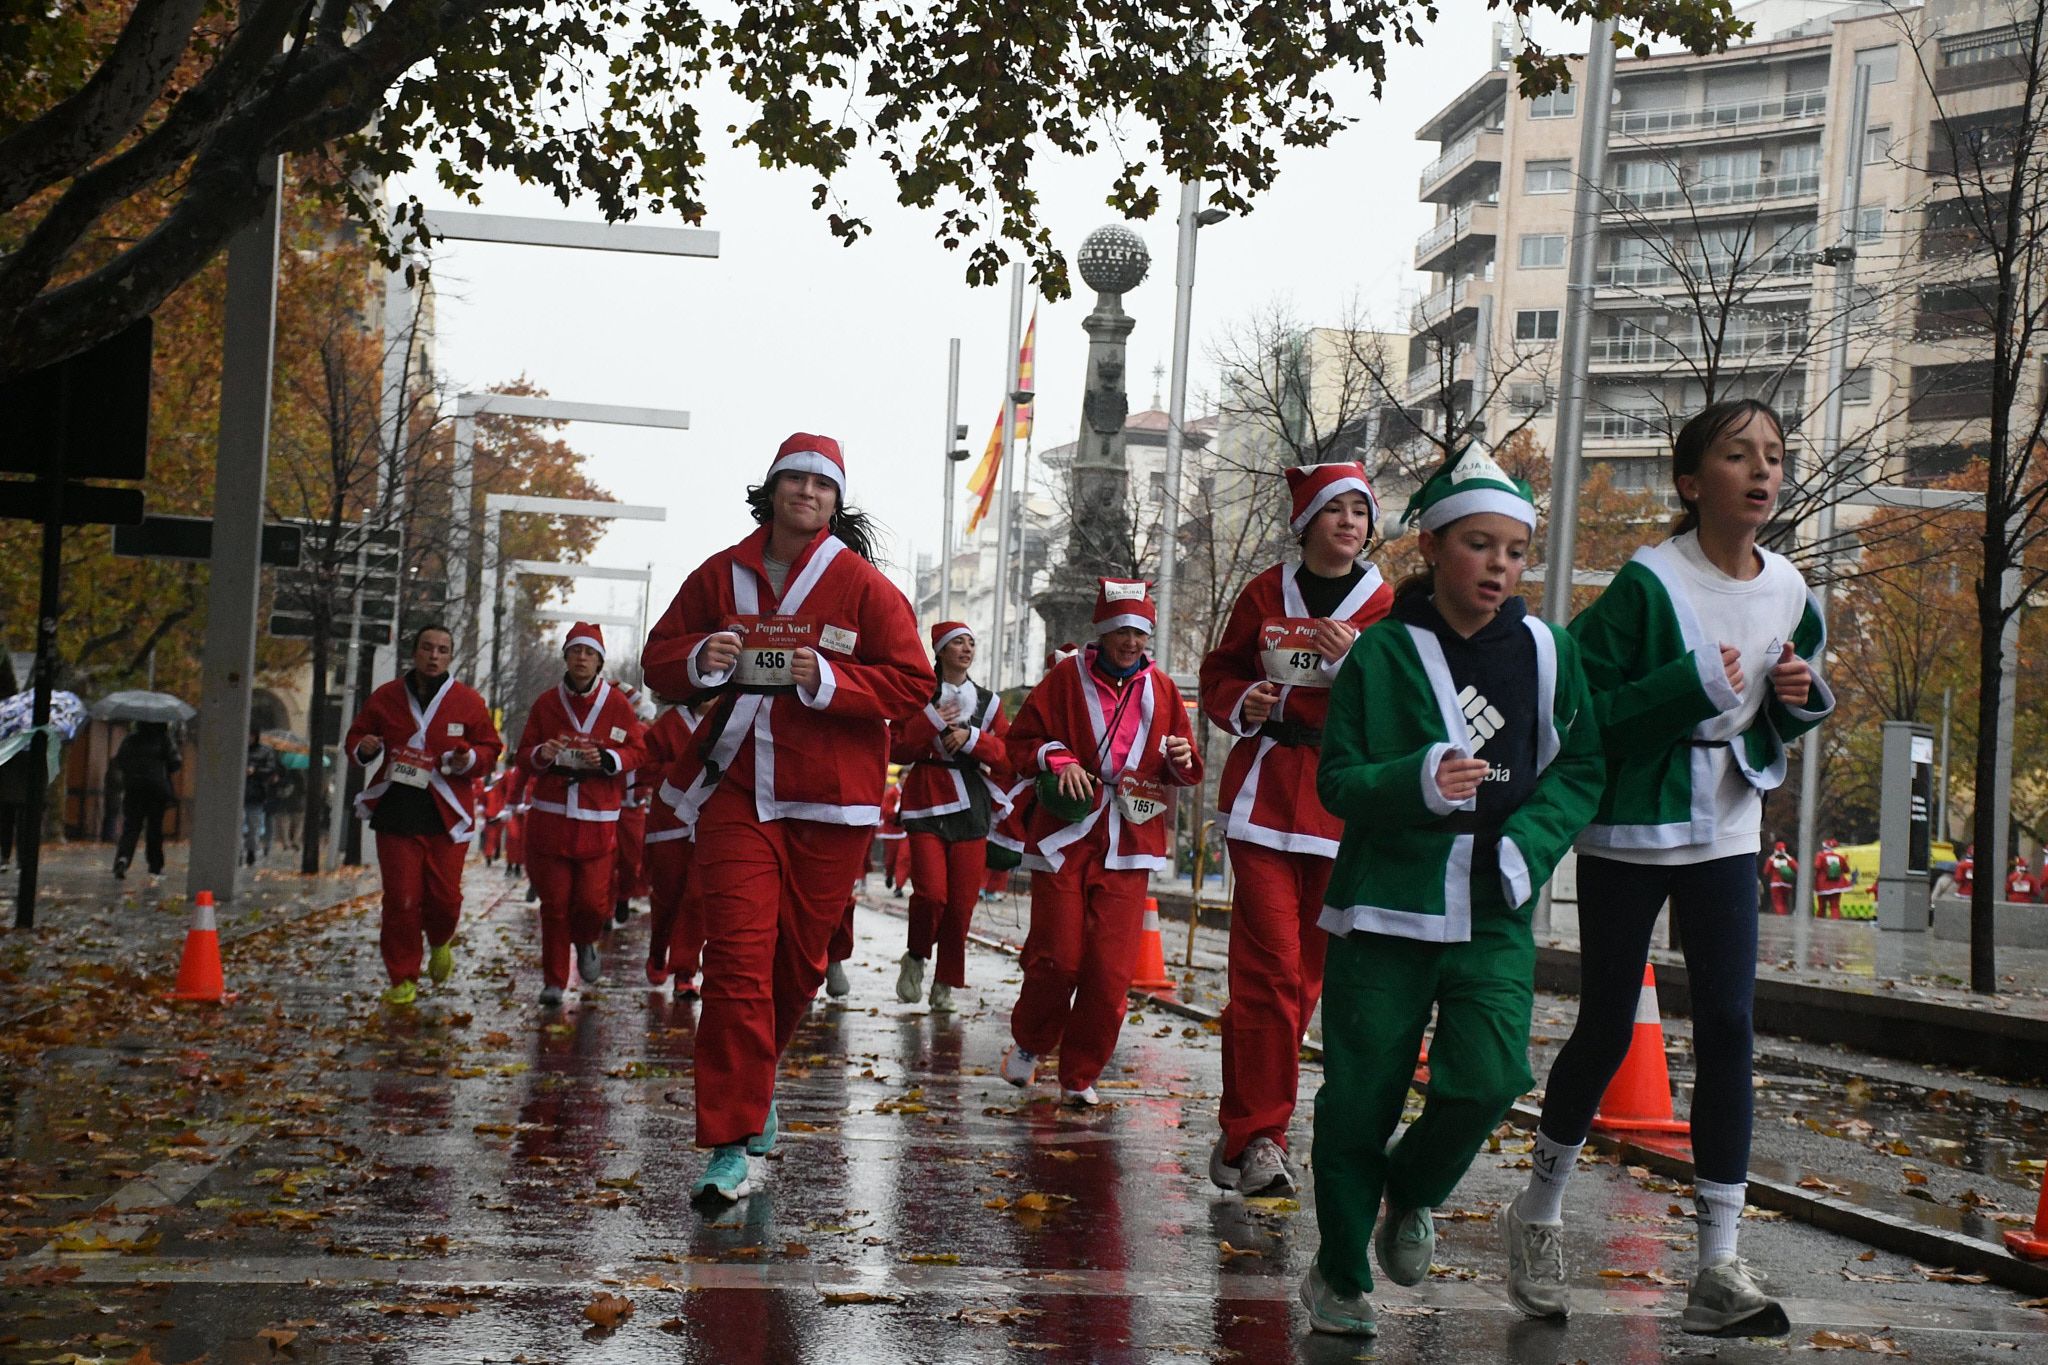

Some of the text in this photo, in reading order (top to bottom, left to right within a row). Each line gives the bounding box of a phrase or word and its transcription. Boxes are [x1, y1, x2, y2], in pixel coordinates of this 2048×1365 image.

[1454, 462, 1482, 473] CAJA
[756, 623, 811, 635] Papá Noel
[755, 651, 785, 669] 436
[1289, 652, 1322, 670] 437
[1132, 799, 1155, 814] 1651
